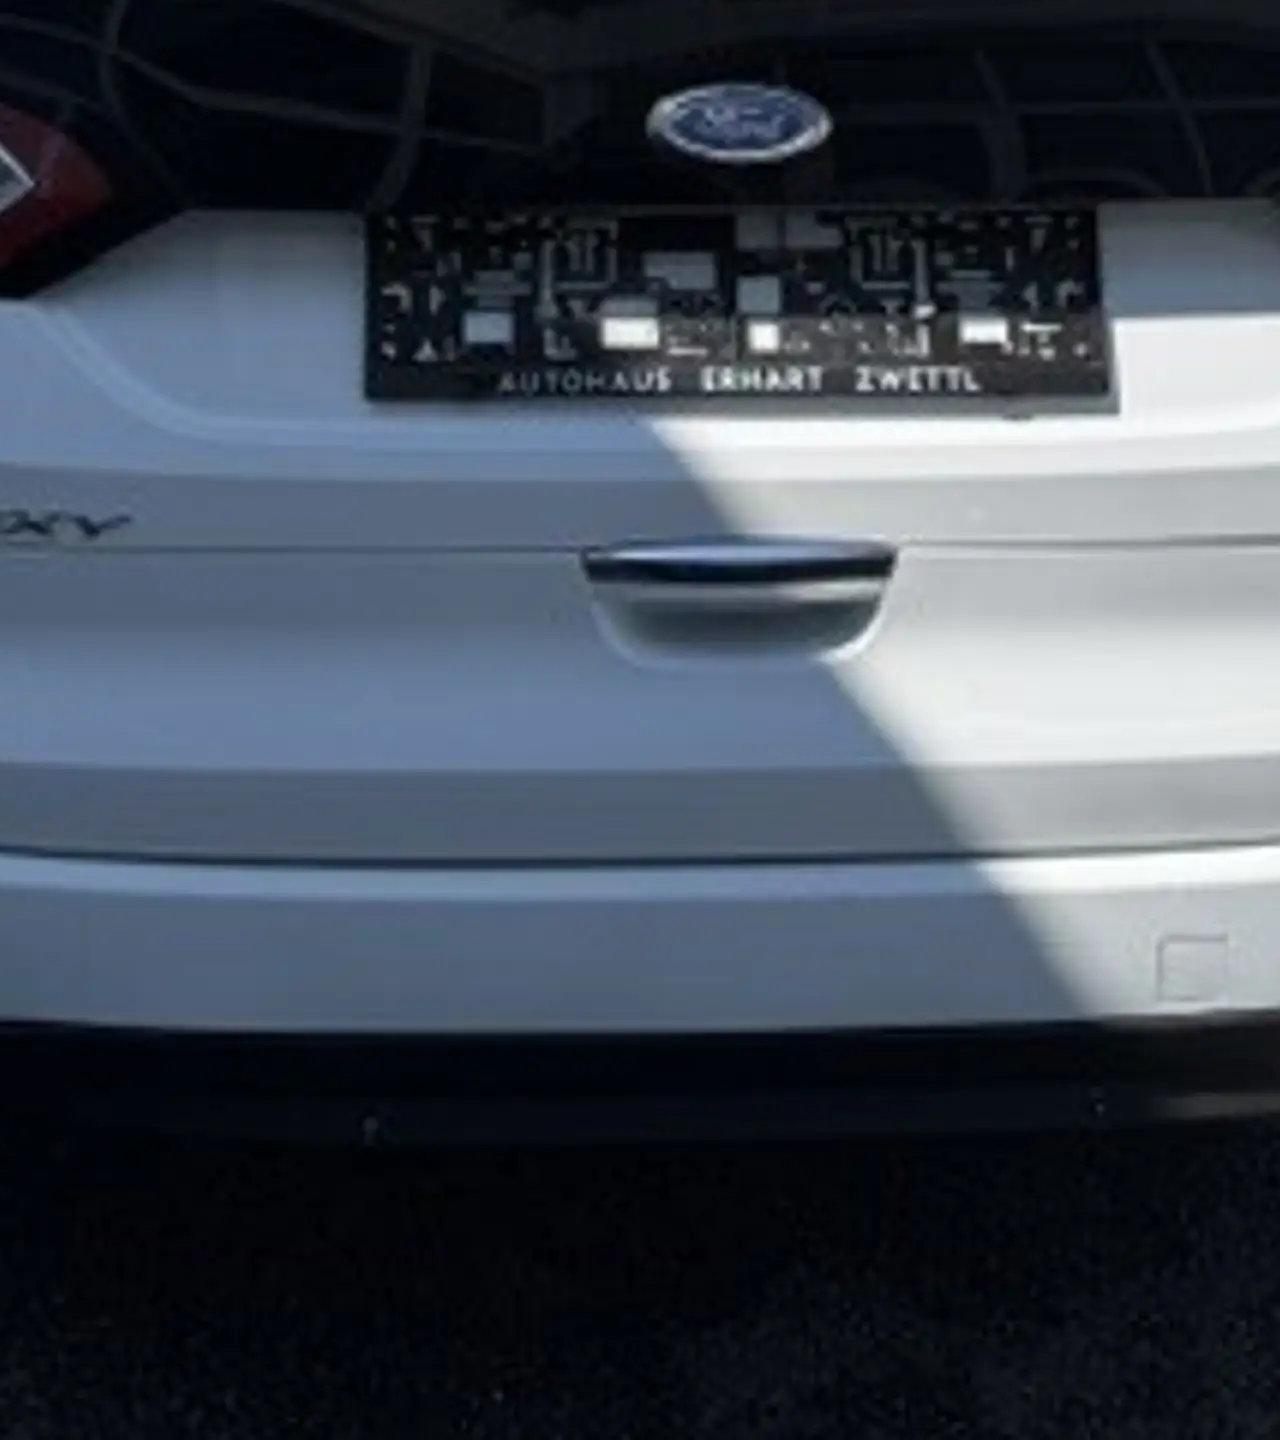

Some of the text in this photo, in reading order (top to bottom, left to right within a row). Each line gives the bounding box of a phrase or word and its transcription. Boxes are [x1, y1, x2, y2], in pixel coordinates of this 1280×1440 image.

[496, 364, 982, 394] AUTOHAUS ERHART ZWETTL
